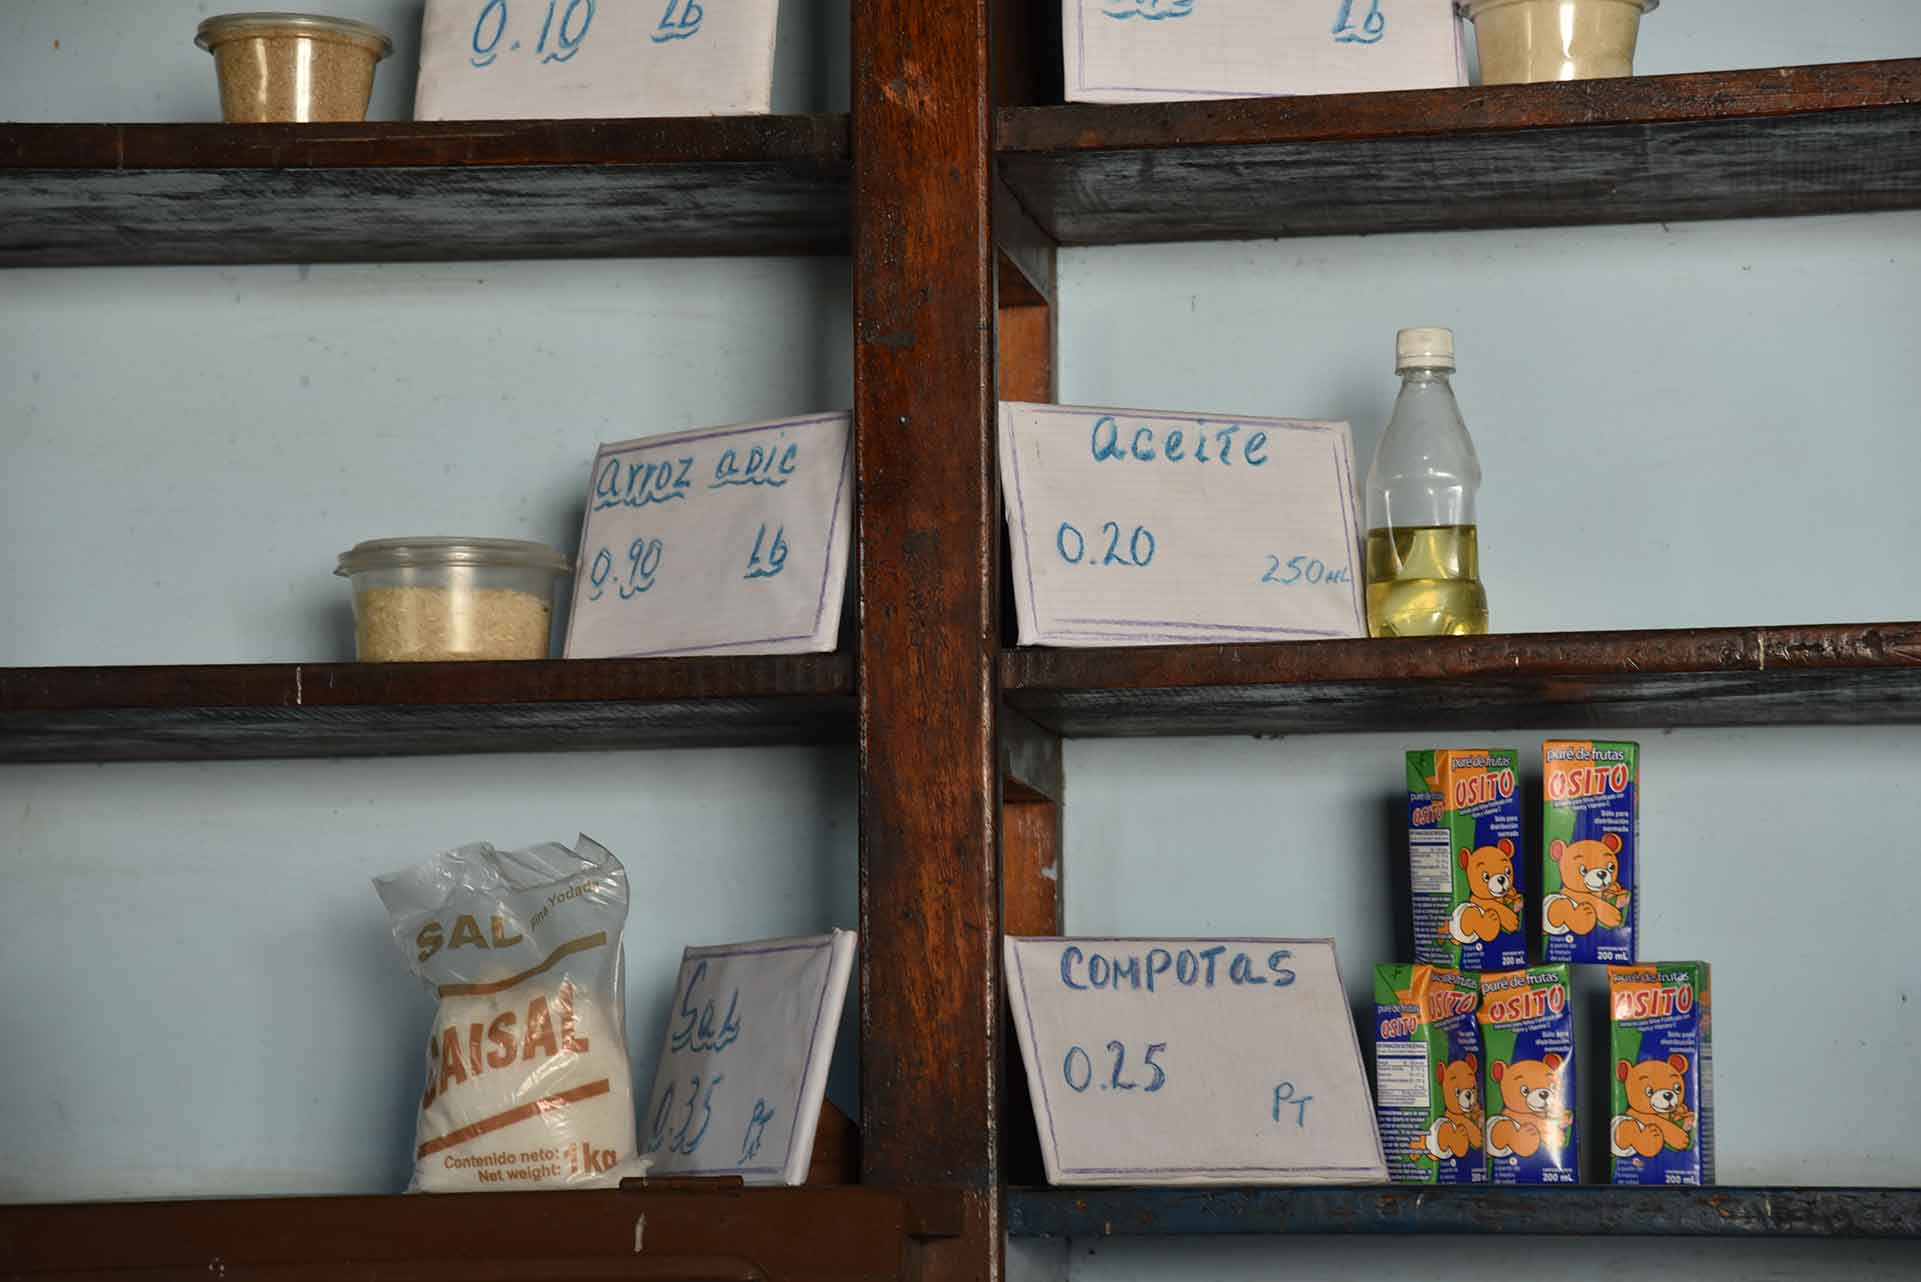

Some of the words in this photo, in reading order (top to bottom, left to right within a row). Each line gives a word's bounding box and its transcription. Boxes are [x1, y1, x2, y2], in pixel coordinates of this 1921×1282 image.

[472, 0, 595, 54] 0.10
[591, 537, 664, 588] 0.90
[1056, 521, 1156, 567] 0.20
[1575, 746, 1590, 761] de
[1591, 746, 1624, 761] frutas
[1454, 768, 1516, 808] OSITO
[1547, 763, 1629, 801] OSITO
[415, 913, 524, 963] SAL
[1597, 951, 1613, 961] 200
[1509, 975, 1525, 987] de
[1526, 972, 1559, 985] frutas
[1488, 984, 1566, 1024] OSITO
[422, 980, 590, 1110] AISAL
[1381, 1015, 1418, 1039] OSITO
[1063, 1040, 1168, 1093] 0.25
[647, 1075, 723, 1156] 0.35
[443, 1151, 517, 1169] Contenido
[521, 1147, 560, 1163] neto:
[478, 1167, 503, 1184] Net
[507, 1163, 561, 1182] weight:
[1665, 1174, 1681, 1184] 200
